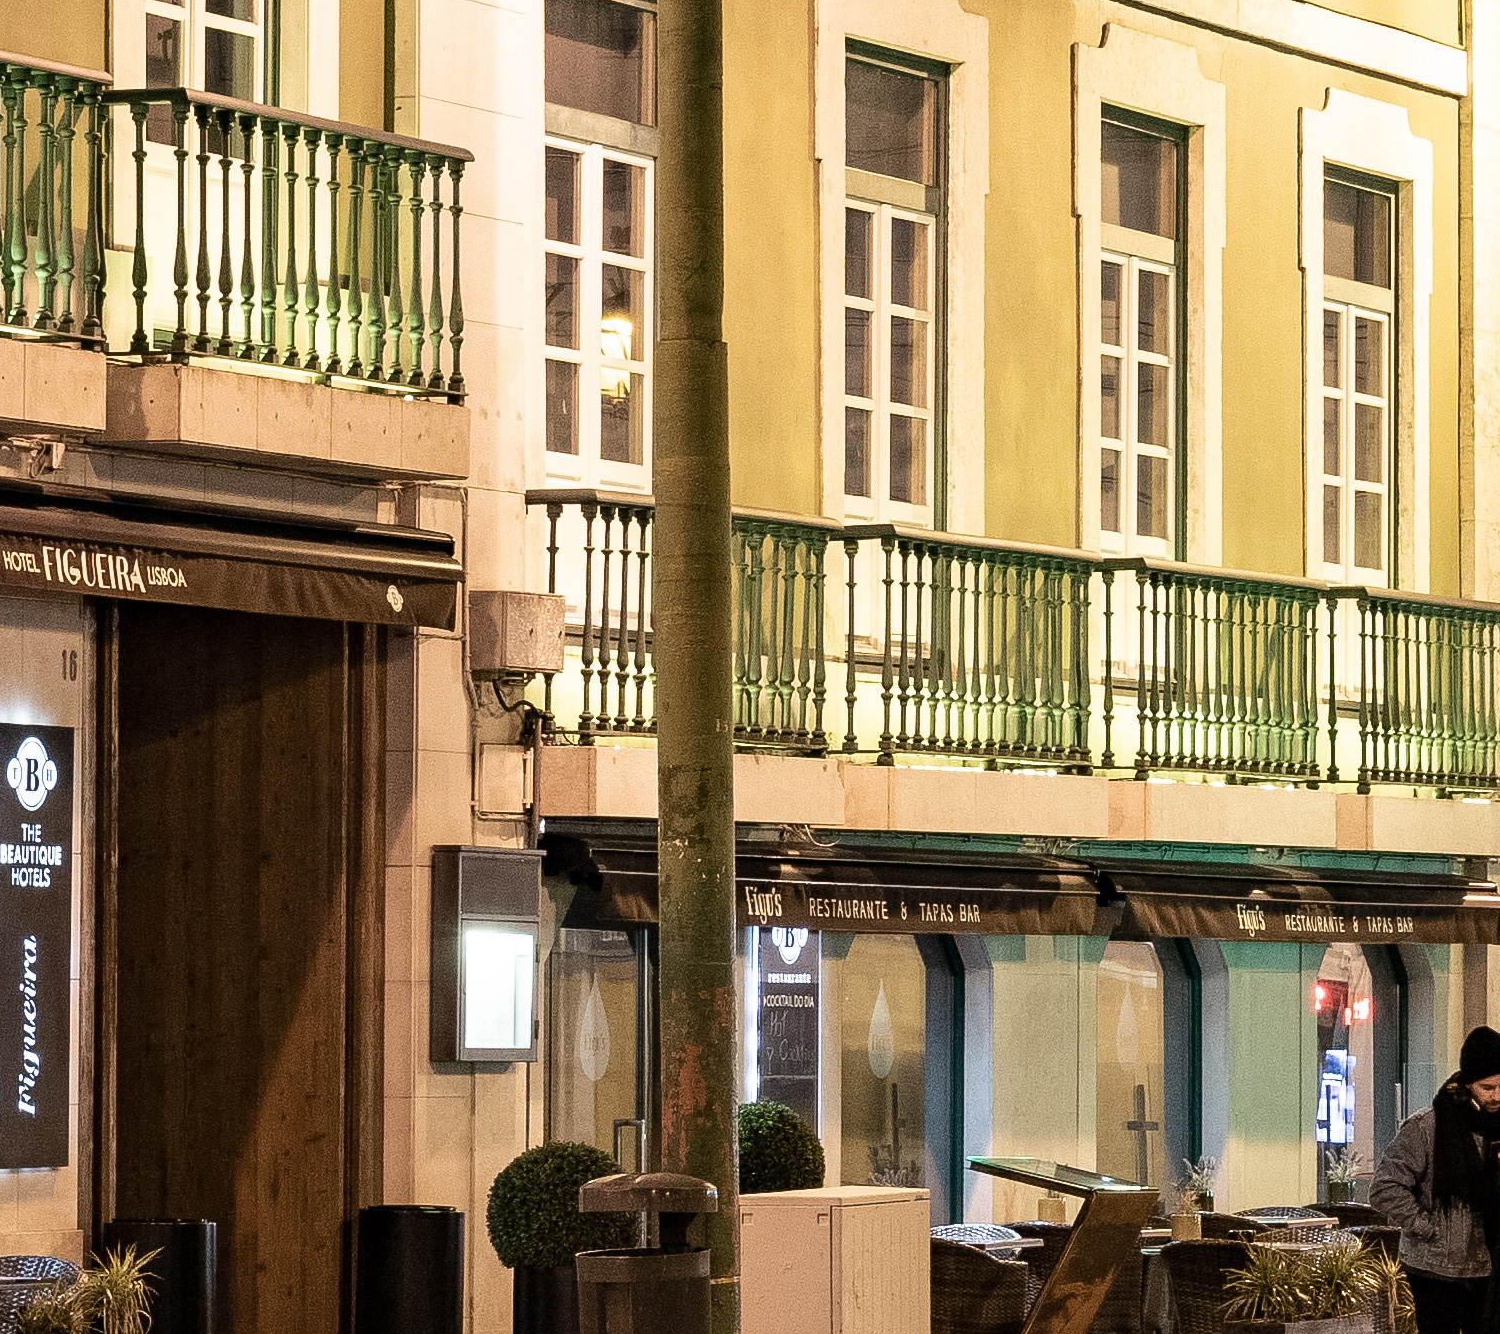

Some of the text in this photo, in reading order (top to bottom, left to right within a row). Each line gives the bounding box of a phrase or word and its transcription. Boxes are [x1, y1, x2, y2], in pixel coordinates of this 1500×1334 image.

[2, 545, 187, 594] HOTEL FIGUEIRA LISBOA
[61, 649, 78, 682] 16
[20, 822, 42, 843] THE
[0, 843, 63, 867] BEAUTIQUE
[11, 867, 51, 888] HOTELS
[808, 897, 889, 920] RESTAURANTE
[900, 901, 908, 921] &
[919, 902, 954, 923] TAPAS
[959, 903, 981, 923] BAR
[1284, 914, 1346, 933] RESTAURANTE
[1352, 915, 1359, 933] &
[1366, 916, 1394, 934] TAPAS
[1397, 916, 1414, 933] BAR
[18, 934, 41, 1118] Figueira
